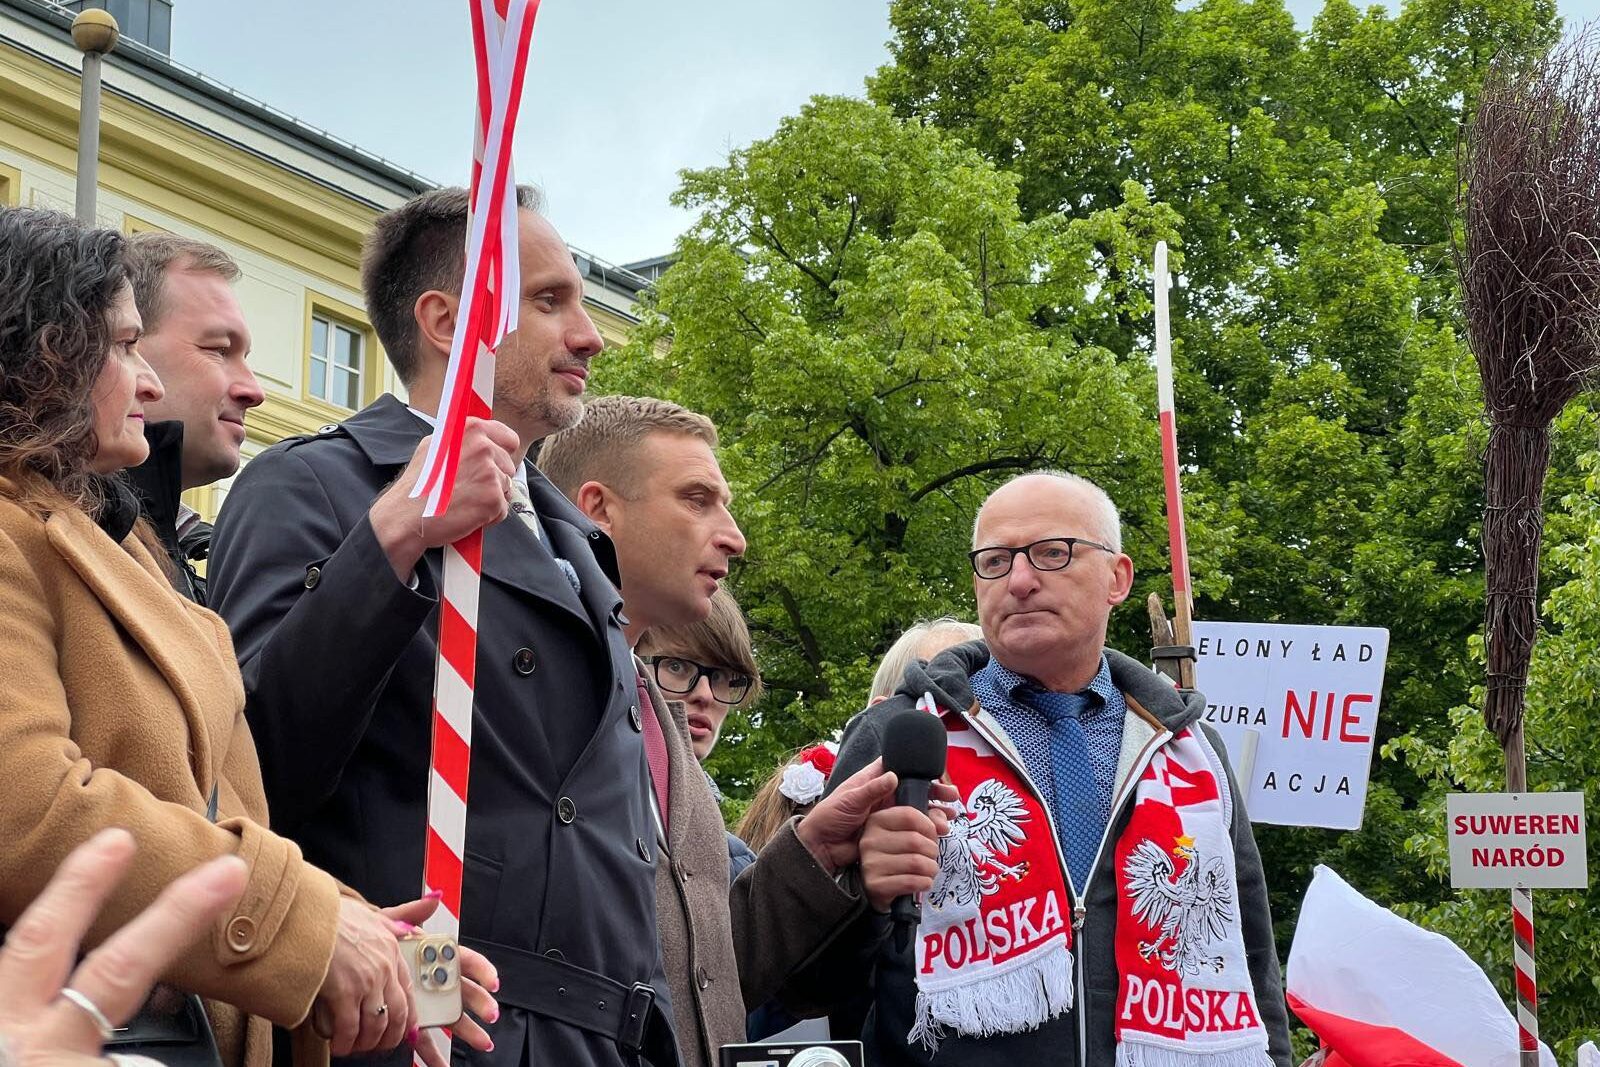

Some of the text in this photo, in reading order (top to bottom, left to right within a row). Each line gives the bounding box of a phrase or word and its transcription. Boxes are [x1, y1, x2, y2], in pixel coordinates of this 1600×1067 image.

[1198, 638, 1373, 662] ELONY ŁAD
[1205, 704, 1267, 725] ZURA
[1281, 690, 1374, 743] NIE
[1263, 771, 1350, 795] ACJA
[1454, 815, 1579, 835] SUWEREN
[1471, 843, 1565, 867] NARÓD
[921, 890, 1064, 973] POLSKA
[1121, 974, 1258, 1033] POLSKA
